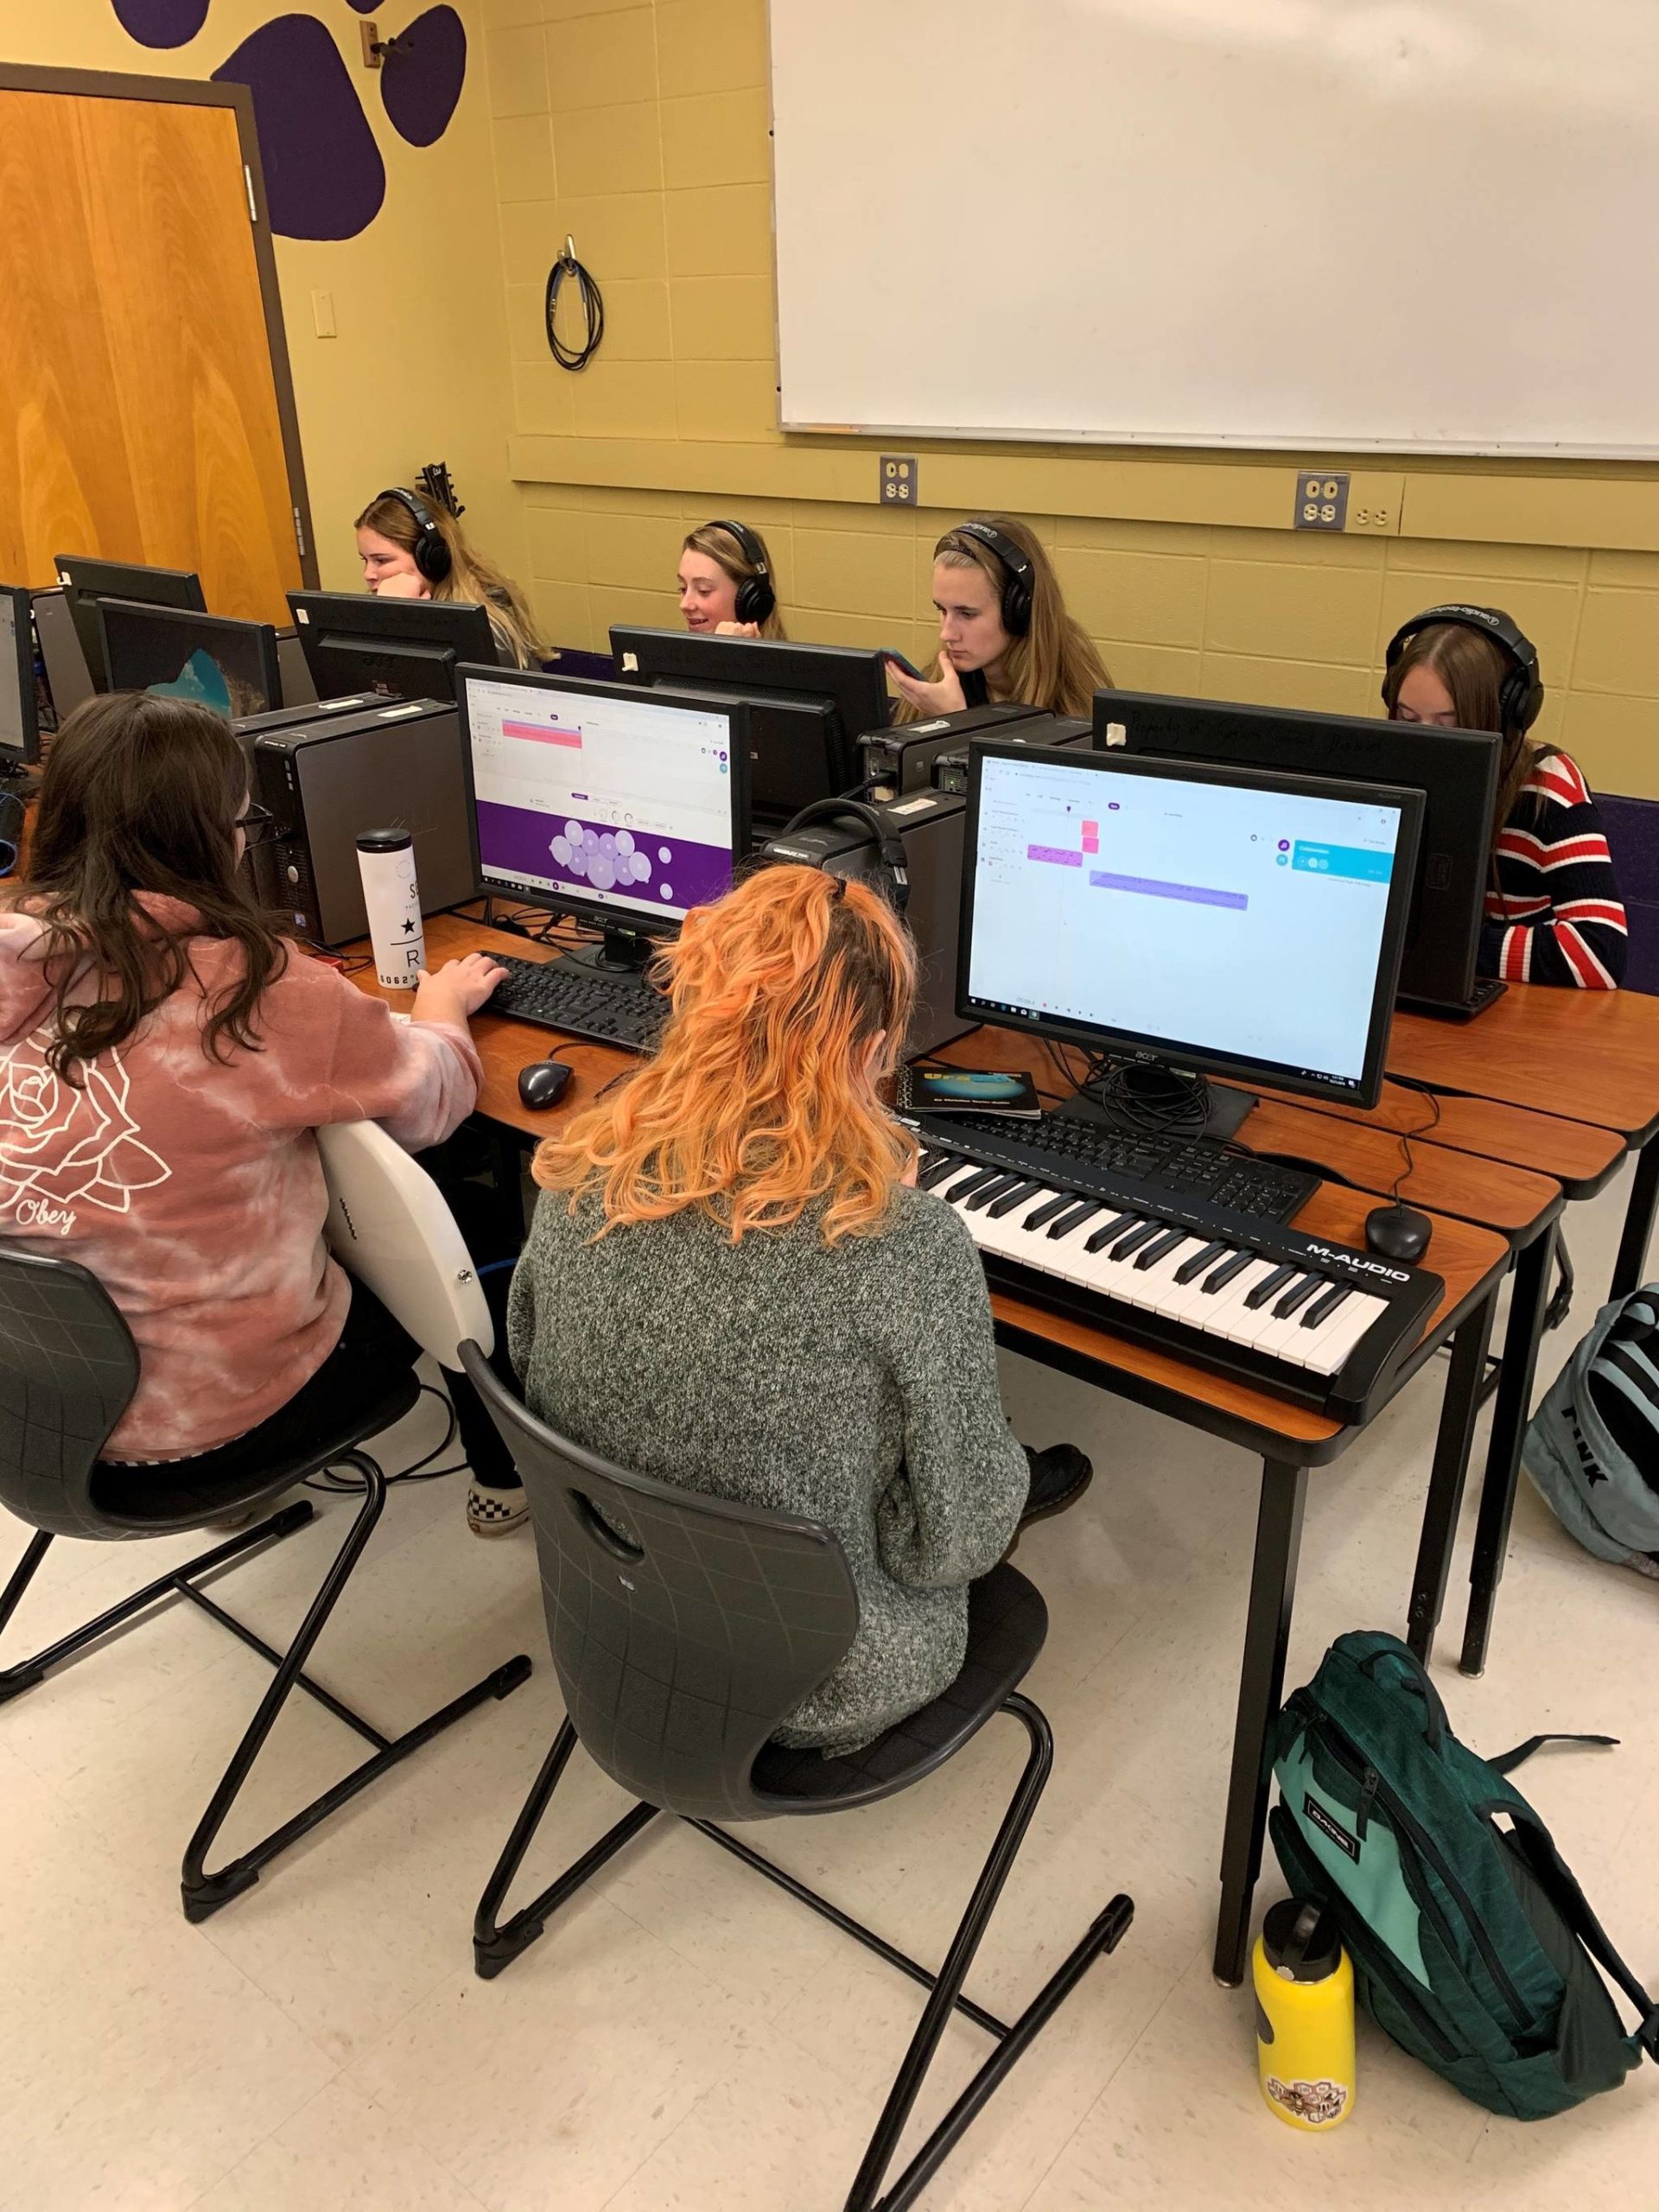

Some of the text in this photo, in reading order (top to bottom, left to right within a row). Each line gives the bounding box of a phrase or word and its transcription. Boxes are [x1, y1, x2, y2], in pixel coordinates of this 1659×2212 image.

[406, 950, 420, 968] R
[1135, 1051, 1159, 1062] acer
[16, 1198, 77, 1236] Obey
[1306, 1243, 1410, 1282] M-AUDIO
